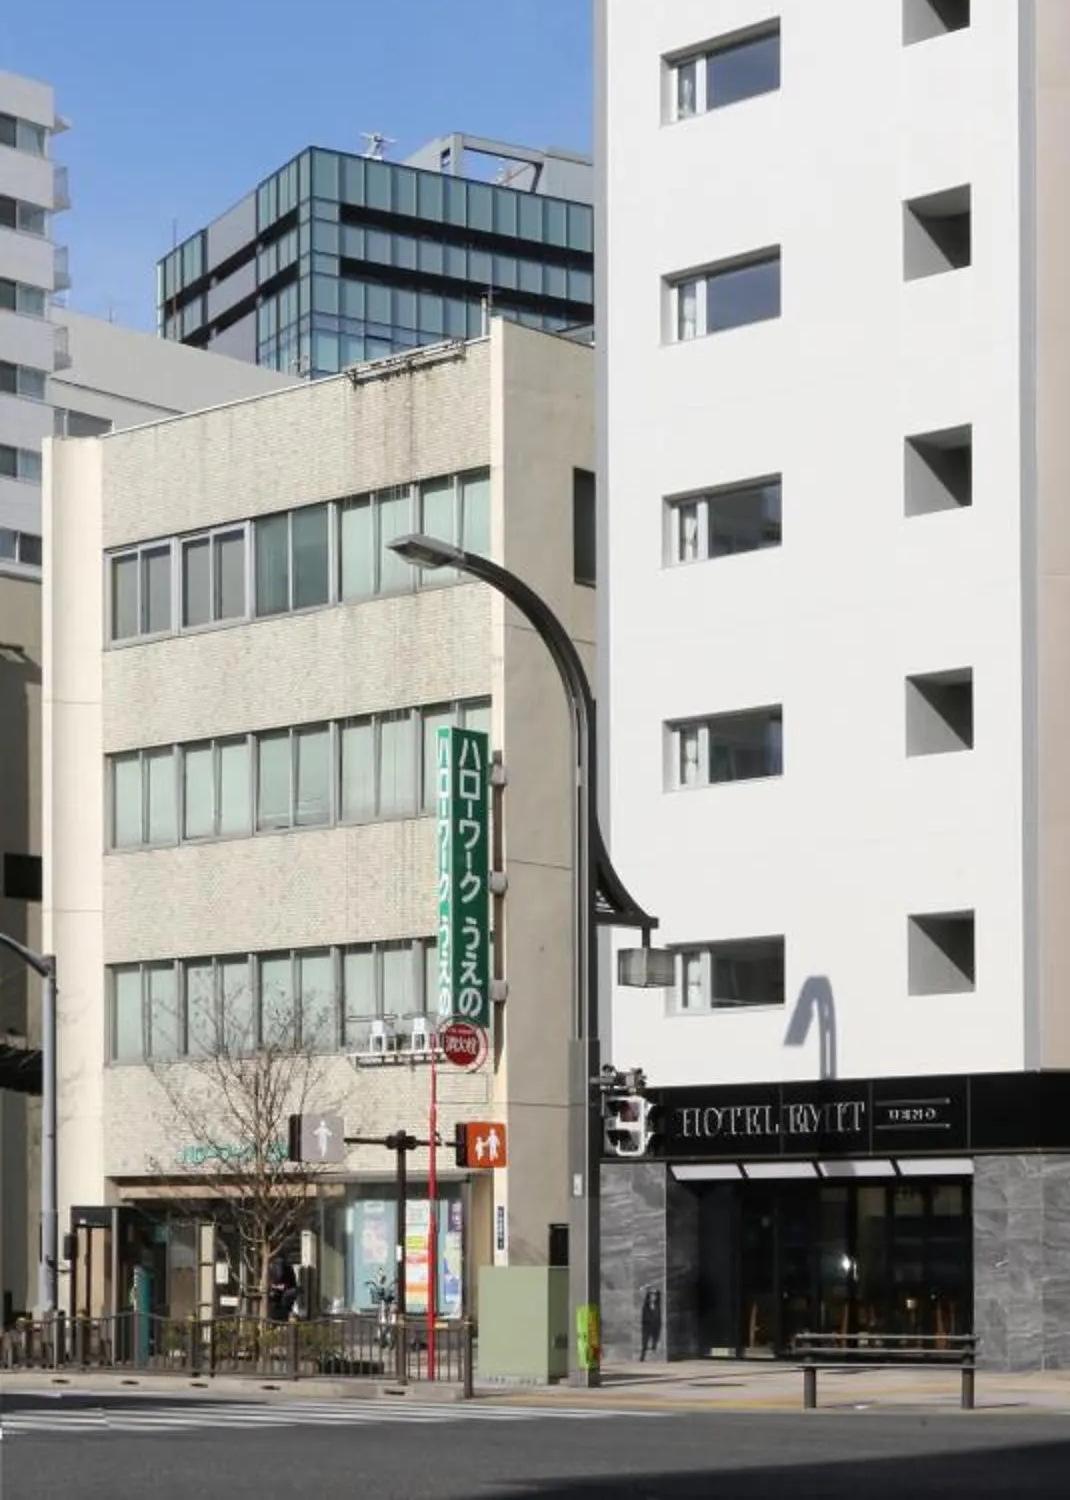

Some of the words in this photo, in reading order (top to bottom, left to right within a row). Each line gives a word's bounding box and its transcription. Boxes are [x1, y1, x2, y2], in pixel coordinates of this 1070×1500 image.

[458, 736, 483, 904] ハローワーク
[459, 916, 483, 1018] うえの
[675, 1104, 781, 1138] HOTEL
[888, 1107, 938, 1122] UENO
